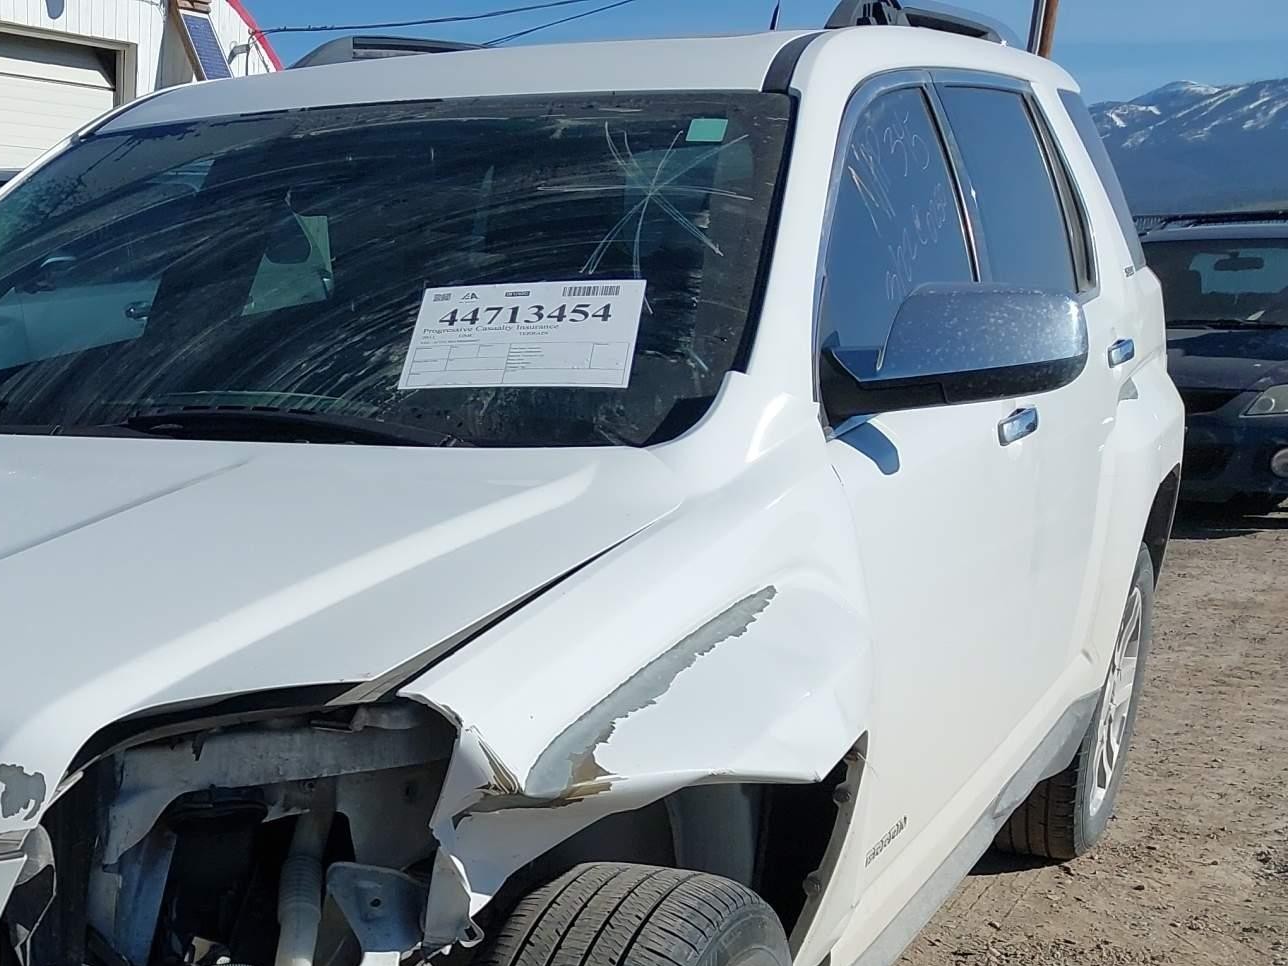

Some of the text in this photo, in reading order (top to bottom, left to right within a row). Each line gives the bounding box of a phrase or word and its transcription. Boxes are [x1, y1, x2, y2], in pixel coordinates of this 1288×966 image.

[438, 303, 613, 326] 44713454
[423, 323, 560, 335] Progressive Casualty Insurance
